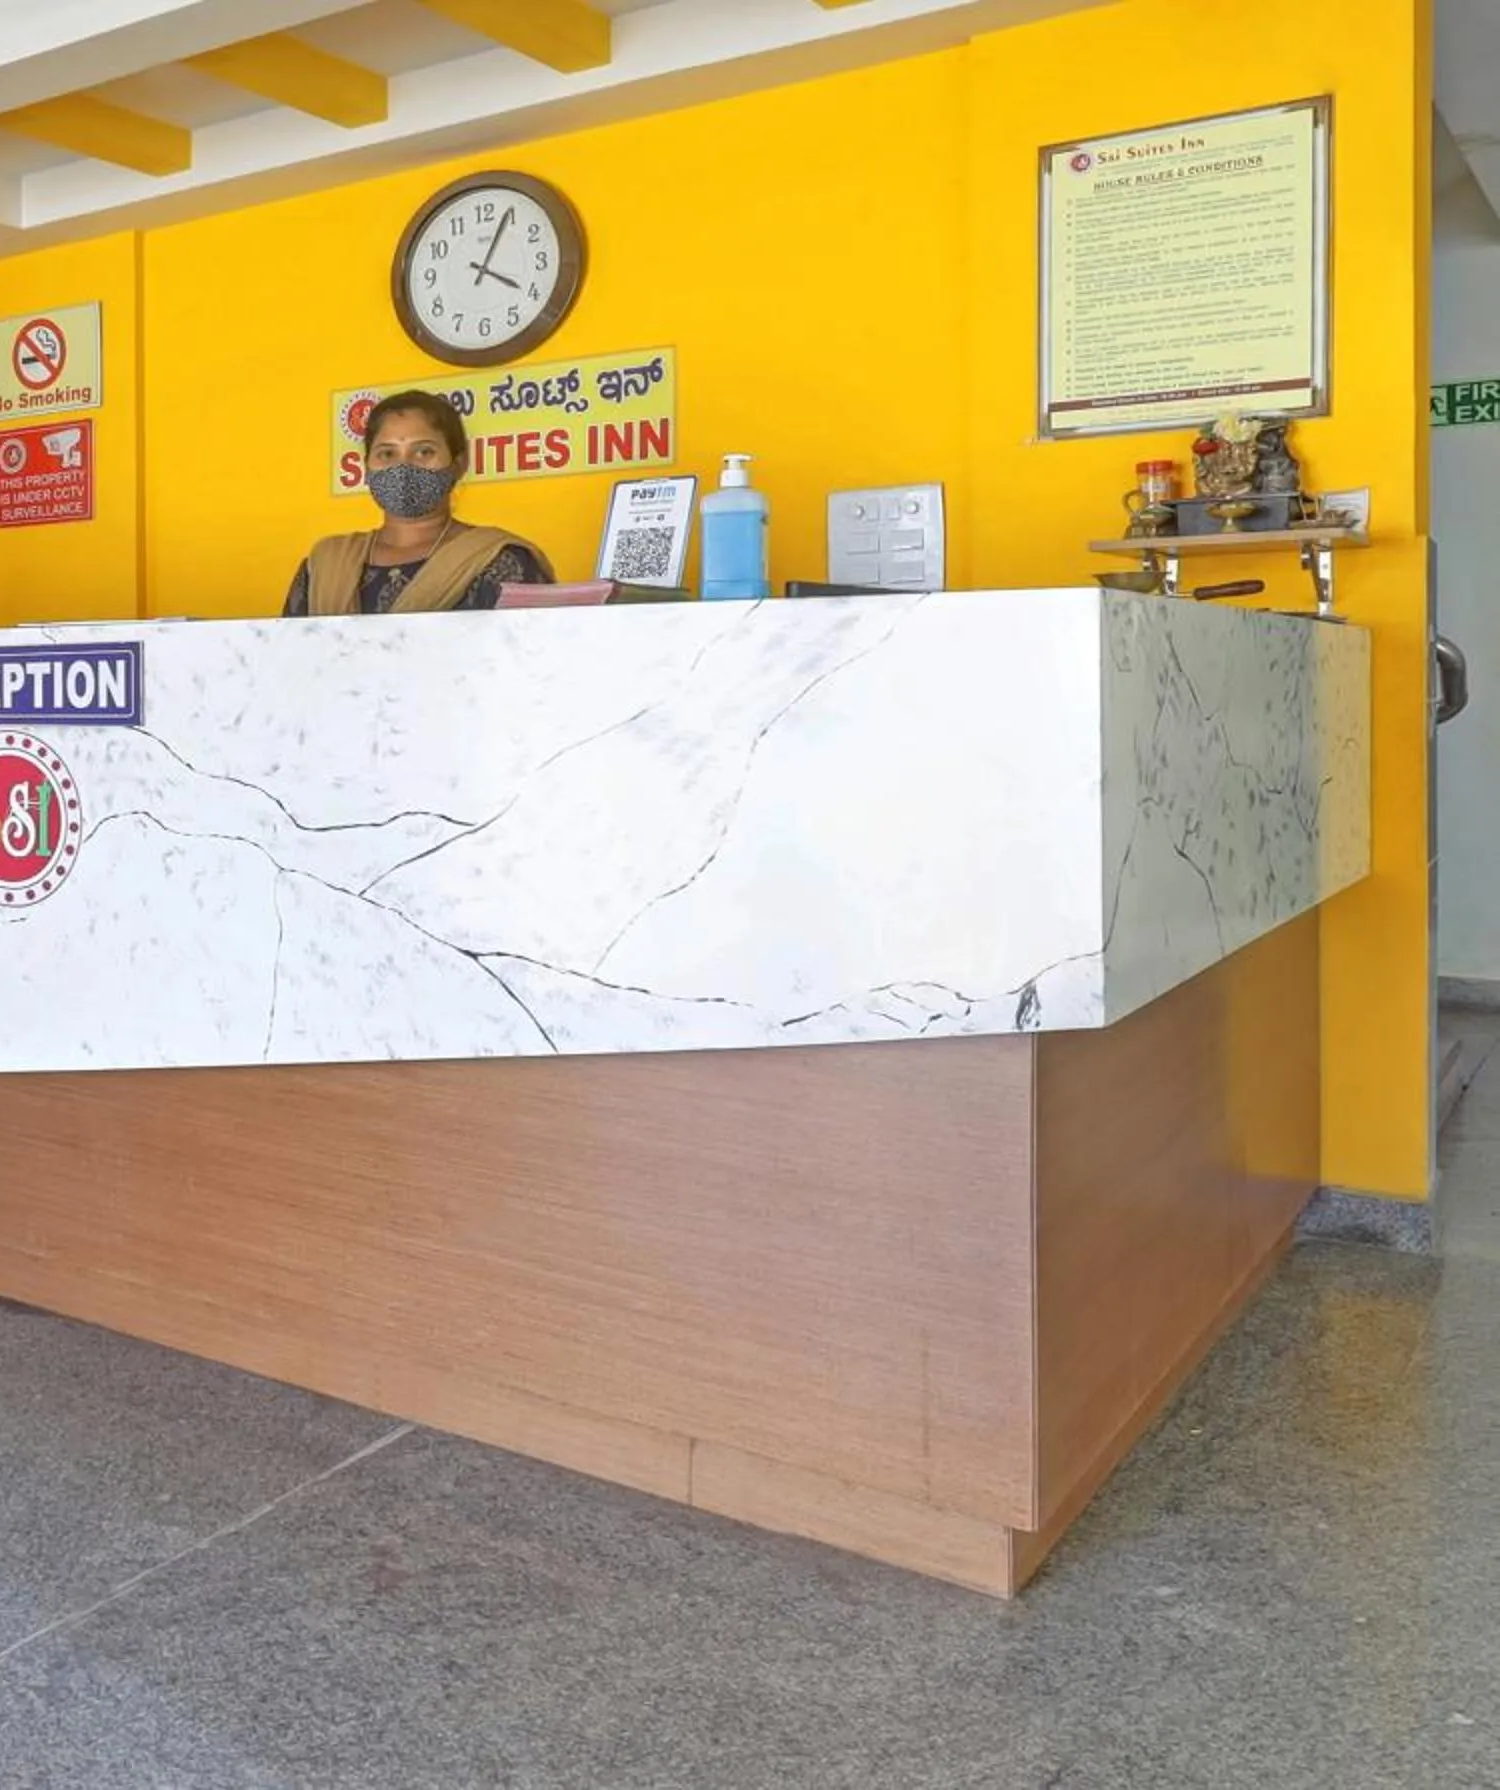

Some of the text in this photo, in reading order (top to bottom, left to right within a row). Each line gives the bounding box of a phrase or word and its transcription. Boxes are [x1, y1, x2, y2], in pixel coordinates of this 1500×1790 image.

[474, 203, 495, 224] 12
[450, 216, 464, 236] 11
[527, 224, 540, 243] 2
[430, 239, 448, 260] 10
[535, 251, 548, 271] 3
[424, 267, 437, 289] 9
[527, 282, 540, 301] 4
[431, 295, 444, 317] 8
[507, 304, 519, 326] 5
[452, 313, 464, 333] 7
[479, 317, 491, 337] 6
[18, 386, 92, 409] Smoking
[1455, 403, 1499, 422] EXI
[474, 417, 670, 475] ITES INN
[1, 470, 85, 489] THIS PROPERTY
[1, 485, 85, 504] IS UNDER CCTV
[2, 502, 84, 520] SURVEILLANCE
